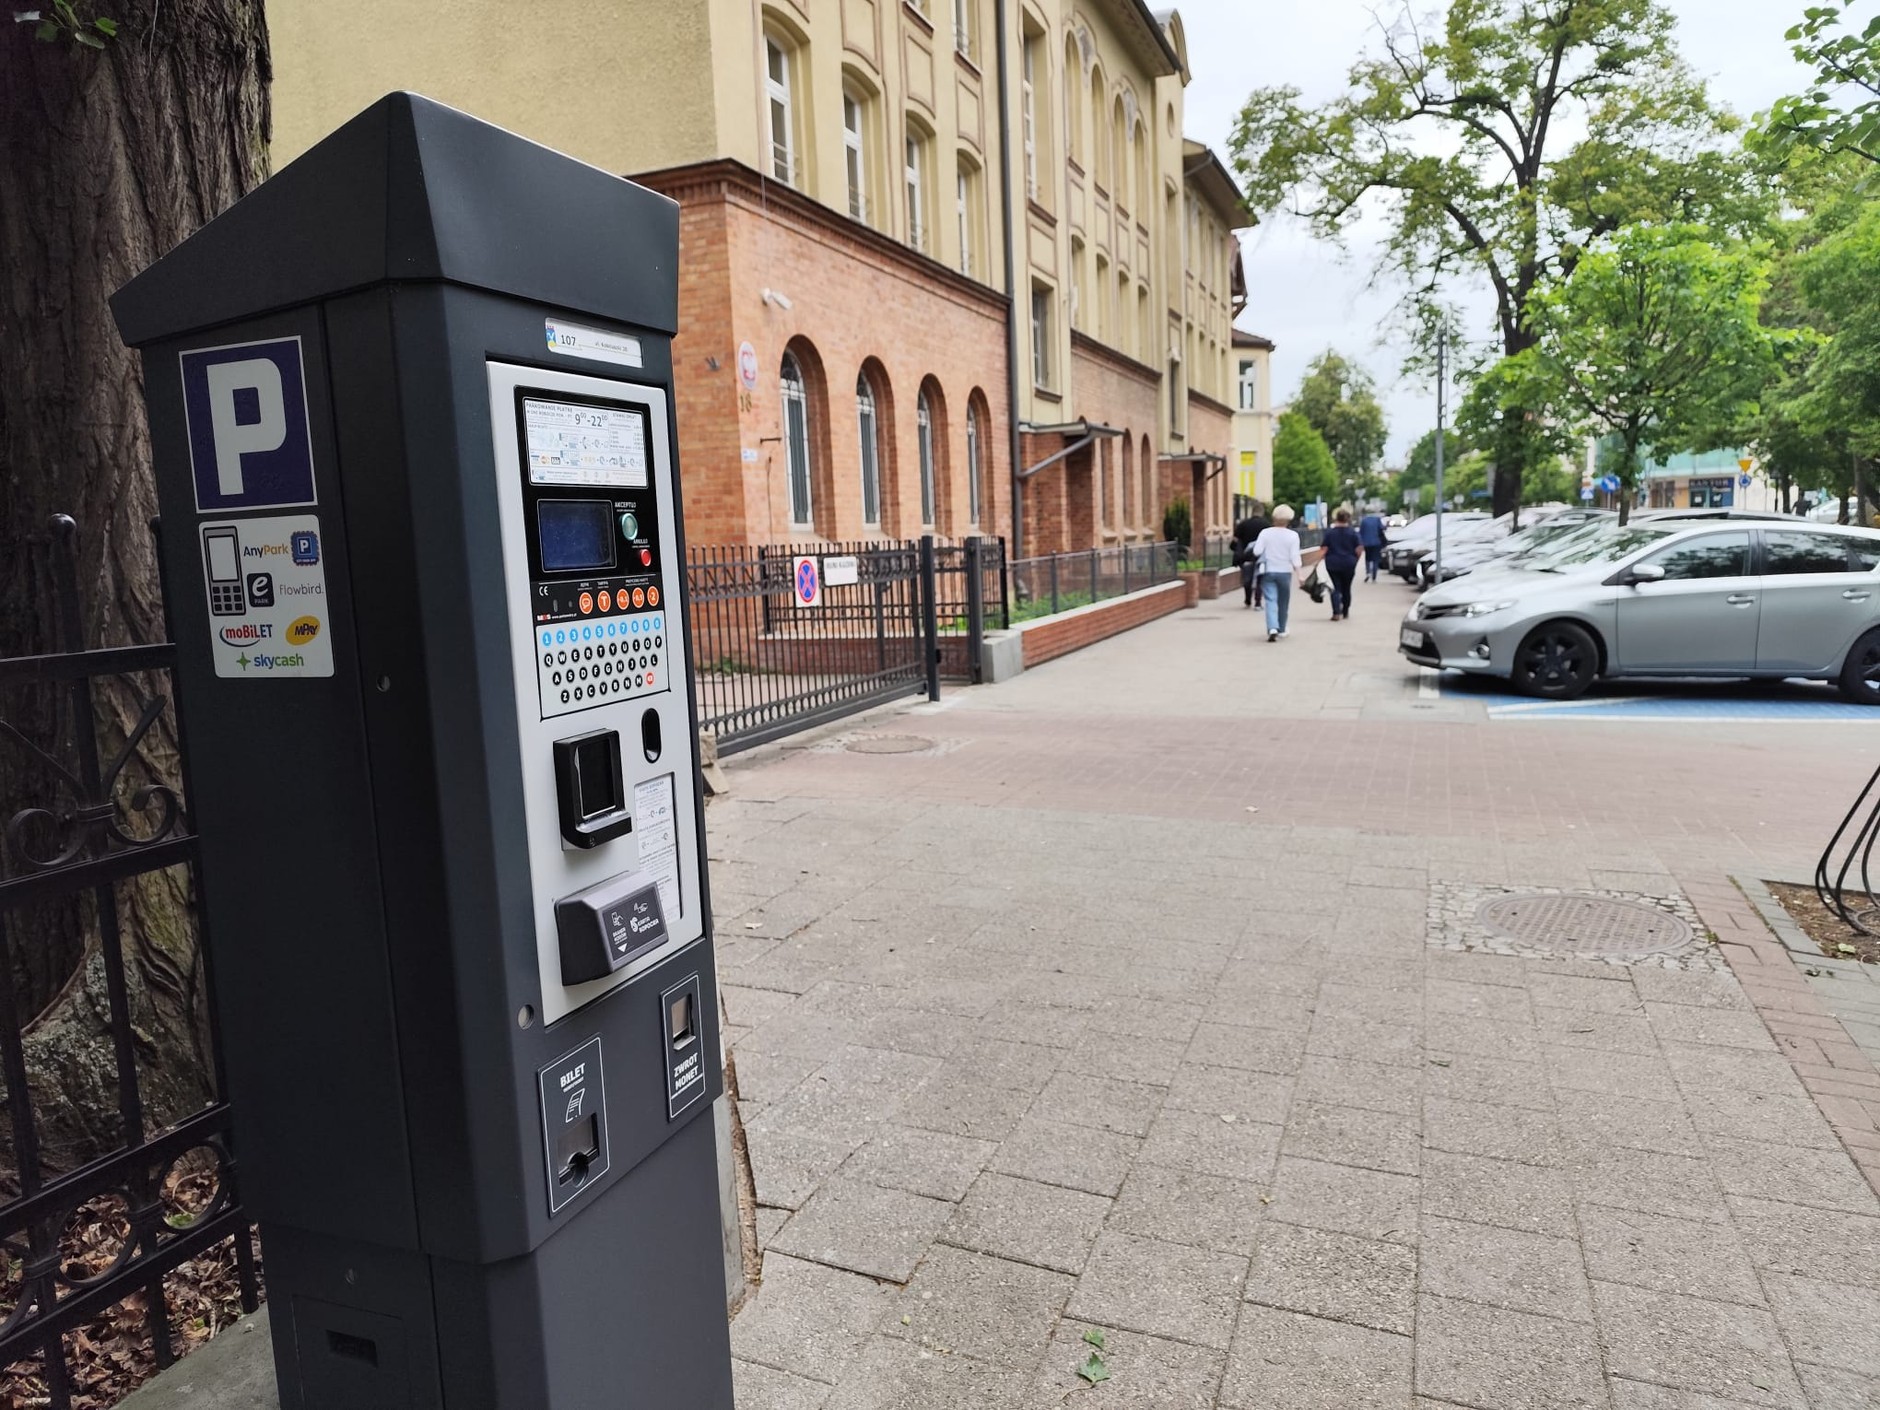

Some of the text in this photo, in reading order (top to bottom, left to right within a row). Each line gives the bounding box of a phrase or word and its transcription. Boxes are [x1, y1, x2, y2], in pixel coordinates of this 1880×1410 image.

[561, 335, 576, 346] 107
[206, 357, 287, 496] P
[243, 543, 290, 558] AnyPark
[253, 653, 305, 670] skycash
[560, 1062, 585, 1088] BILET
[674, 1052, 698, 1078] ZWROT
[675, 1065, 698, 1090] MONET
